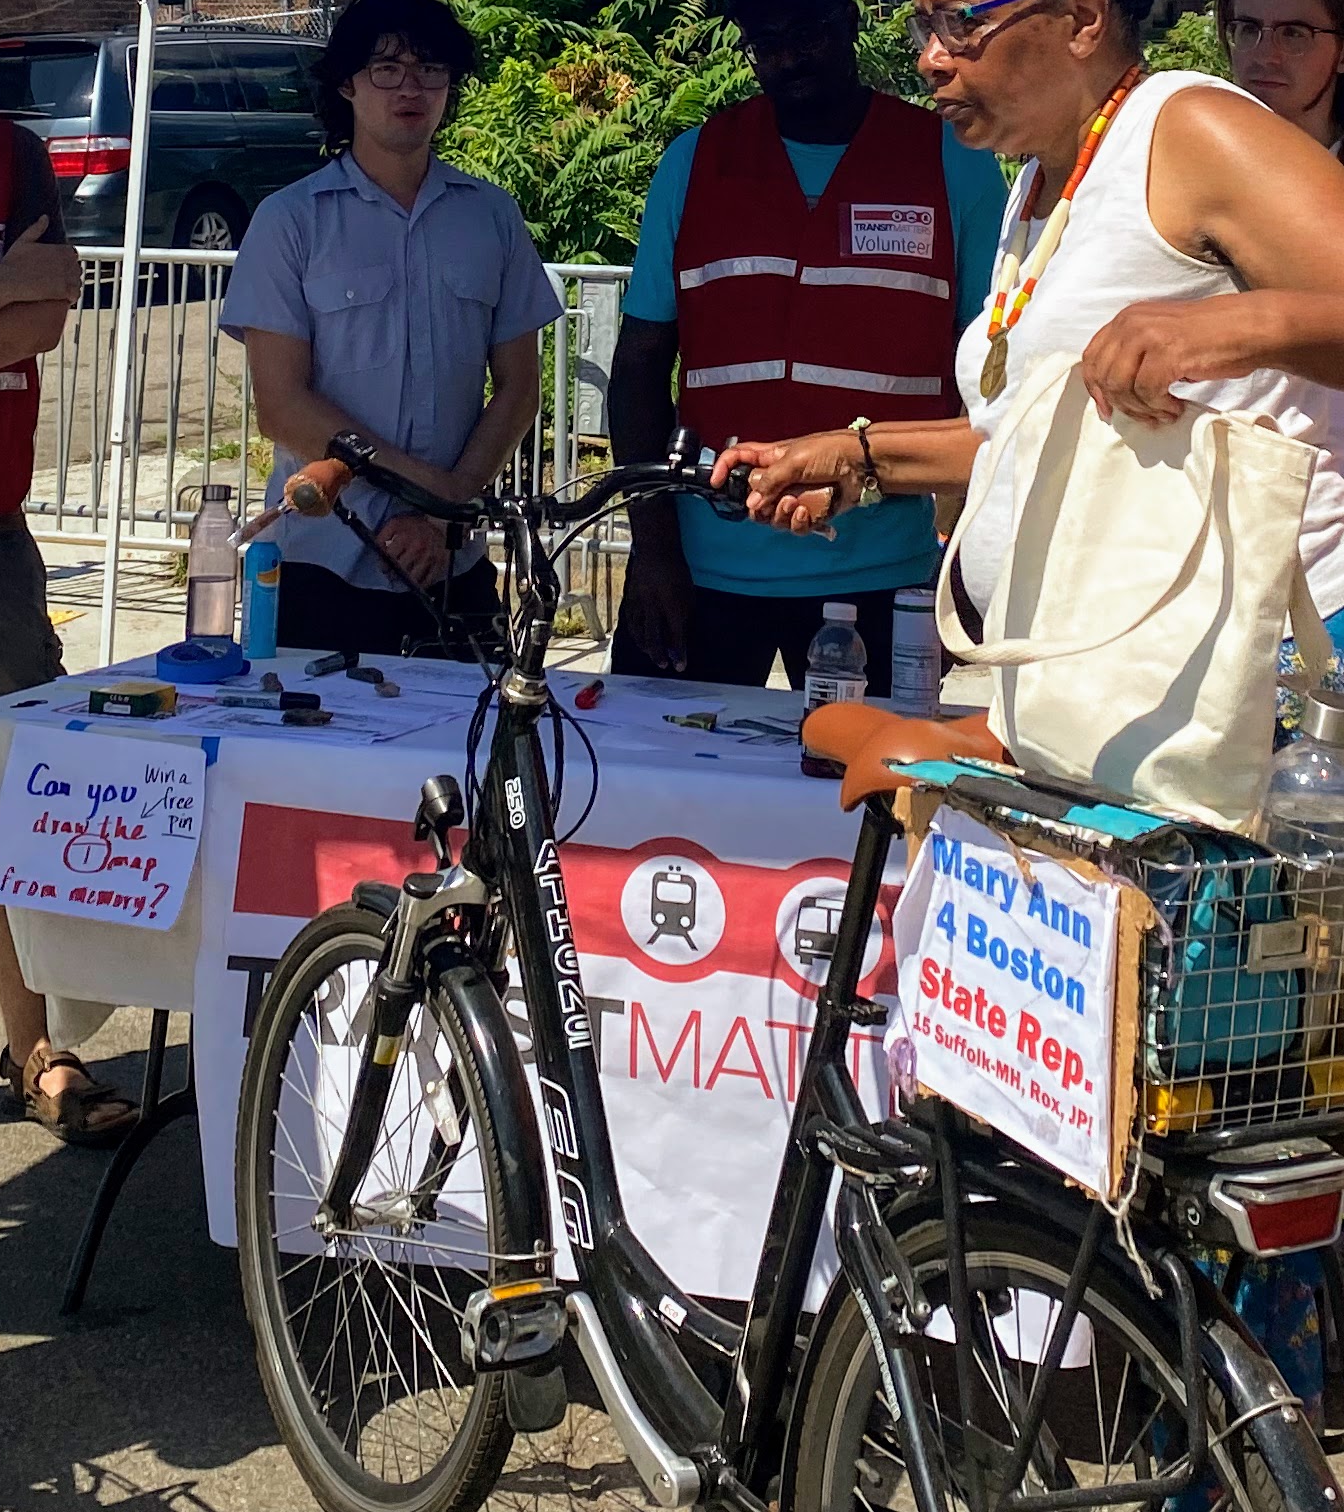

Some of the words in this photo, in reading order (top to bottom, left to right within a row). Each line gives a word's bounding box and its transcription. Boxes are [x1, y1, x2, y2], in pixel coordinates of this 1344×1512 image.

[854, 235, 932, 256] Volunteer
[26, 762, 71, 797] Can
[87, 782, 138, 820] you
[161, 787, 195, 811] free
[178, 771, 193, 785] a
[504, 776, 527, 830] 250
[33, 812, 91, 836] draw
[97, 815, 148, 840] the
[168, 815, 193, 832] pin
[0, 866, 58, 896] from
[68, 883, 170, 919] memory?
[106, 856, 158, 882] map
[932, 833, 1019, 913] Mary
[1027, 881, 1092, 949] Ann
[936, 901, 956, 943] 4
[967, 913, 1086, 1015] Boston
[919, 957, 1007, 1038] State
[1017, 1009, 1094, 1094] Rep.
[913, 1012, 931, 1036] 15
[934, 1024, 1025, 1098] Suffolk-MH,
[1030, 1079, 1064, 1124] Rox,
[1069, 1105, 1094, 1137] JP!
